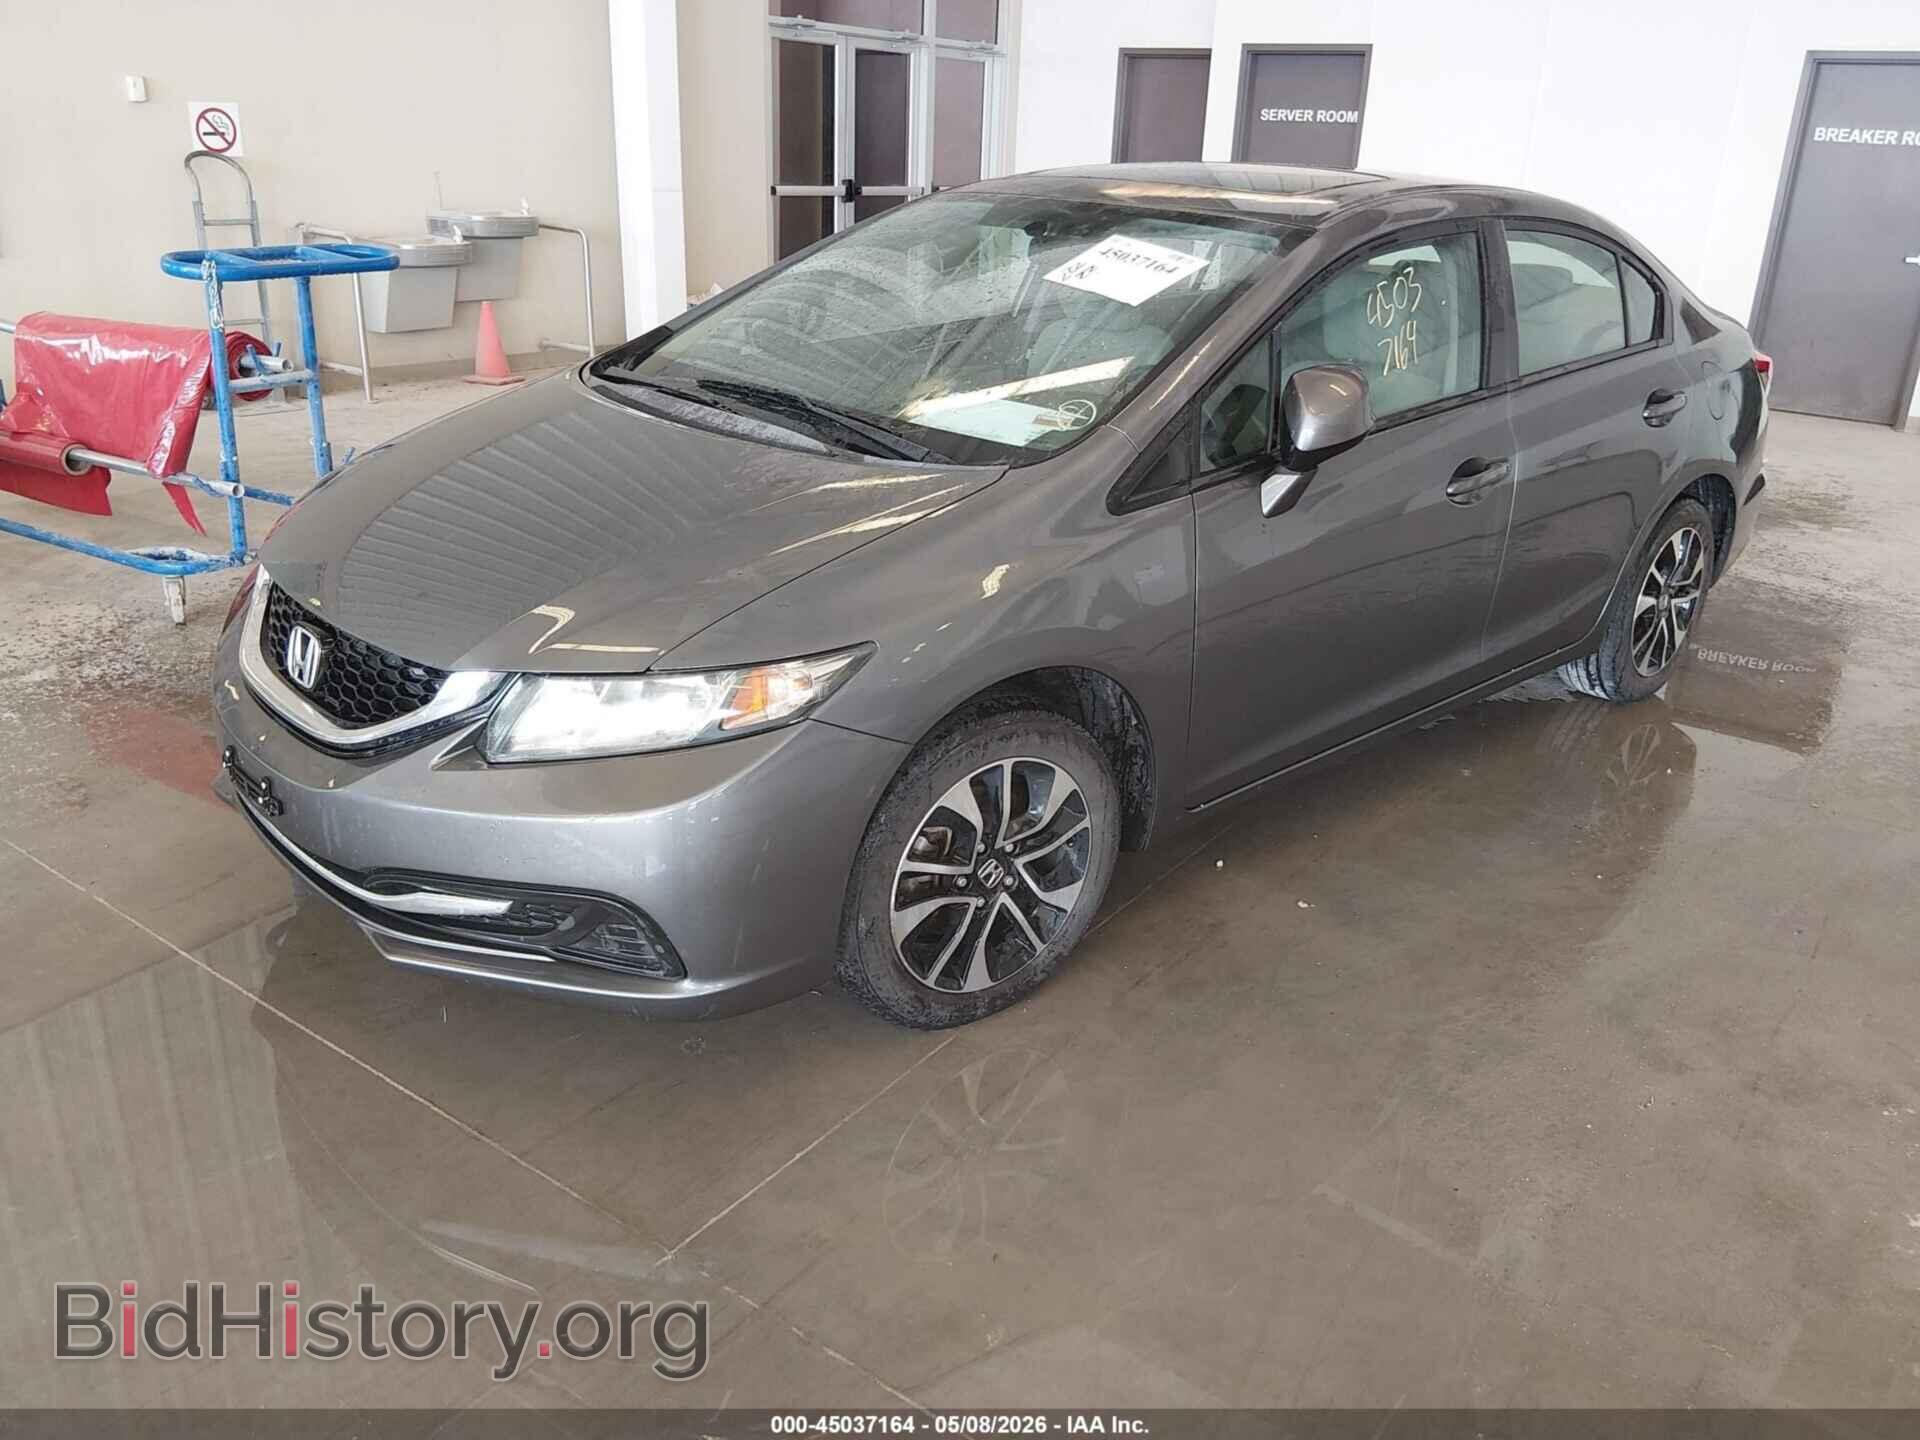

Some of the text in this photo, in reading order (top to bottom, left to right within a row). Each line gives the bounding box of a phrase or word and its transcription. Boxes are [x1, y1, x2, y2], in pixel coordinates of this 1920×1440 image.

[1260, 108, 1359, 123] SERVER ROOM
[1813, 127, 1898, 145] BREAKER
[1367, 266, 1422, 329] 4503
[1377, 319, 1418, 377] 7164
